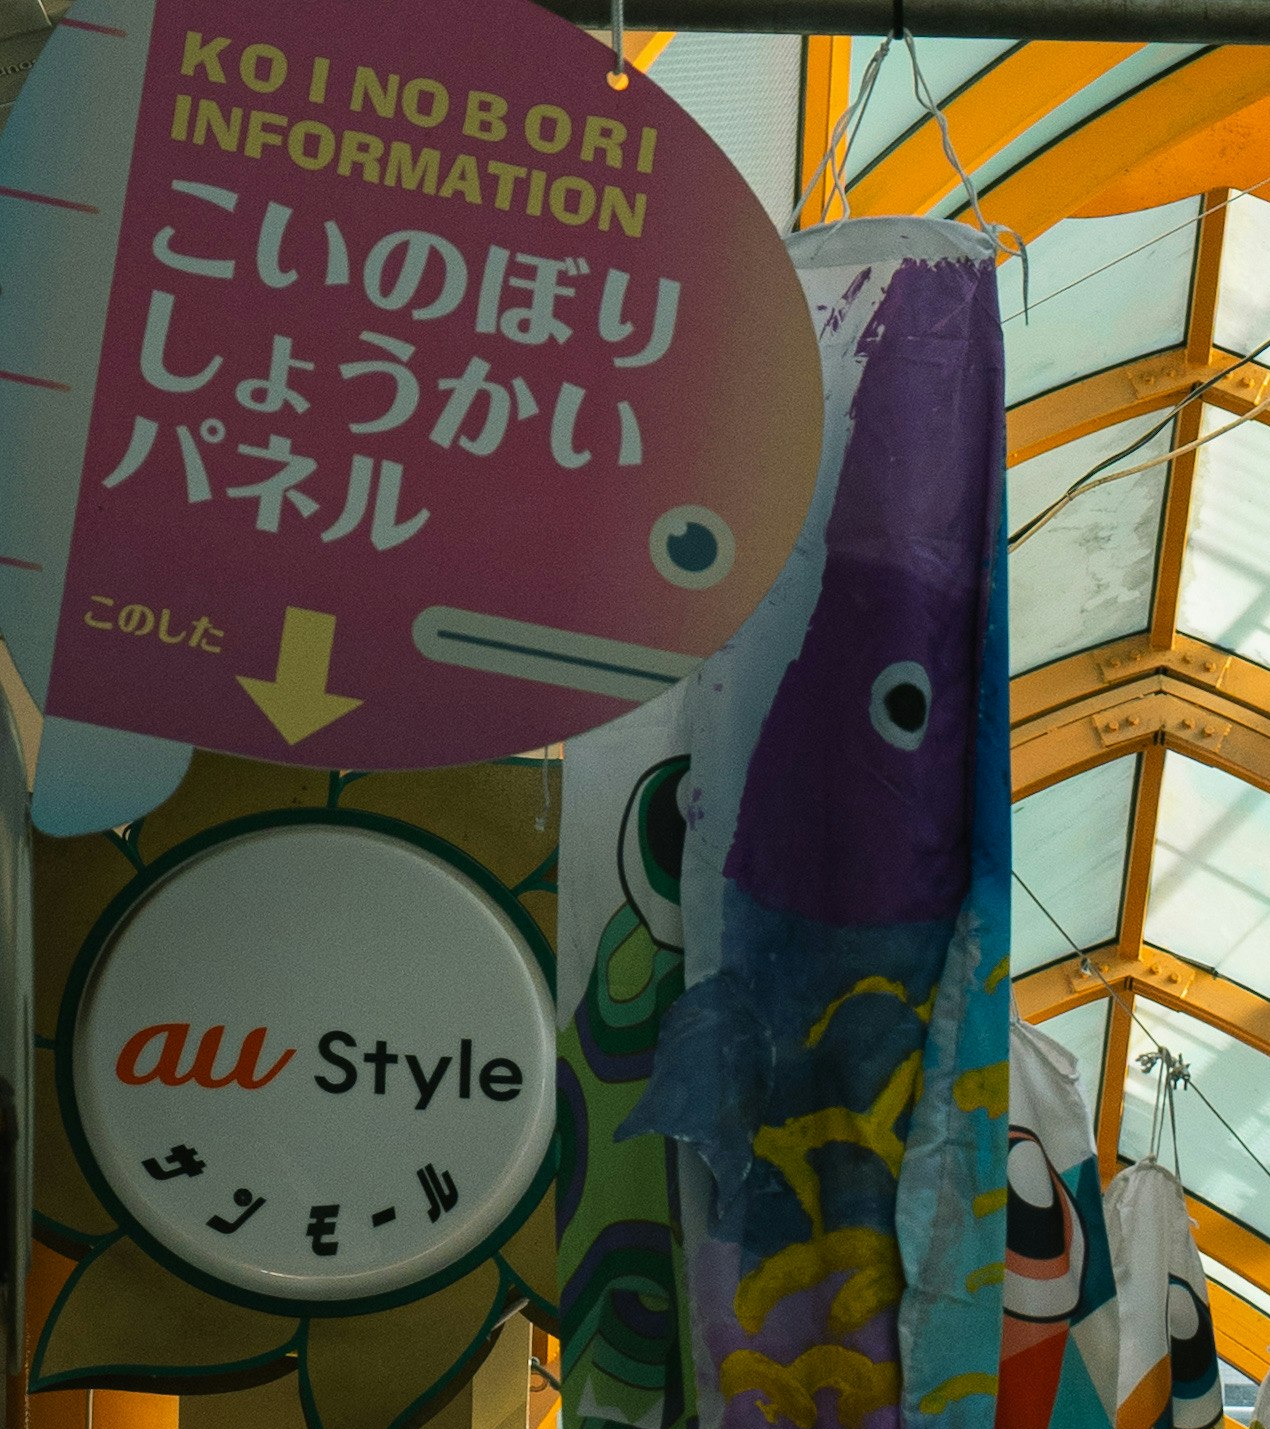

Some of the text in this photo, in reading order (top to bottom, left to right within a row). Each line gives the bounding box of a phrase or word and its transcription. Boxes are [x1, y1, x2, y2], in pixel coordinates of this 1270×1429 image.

[171, 95, 648, 238] INFORMATION
[152, 179, 682, 369] こいのぼり
[138, 290, 644, 469] しょうかい
[102, 415, 431, 552] パネル
[83, 596, 226, 654] このした
[115, 1022, 524, 1110] au Style
[142, 1144, 459, 1256] サンモール
